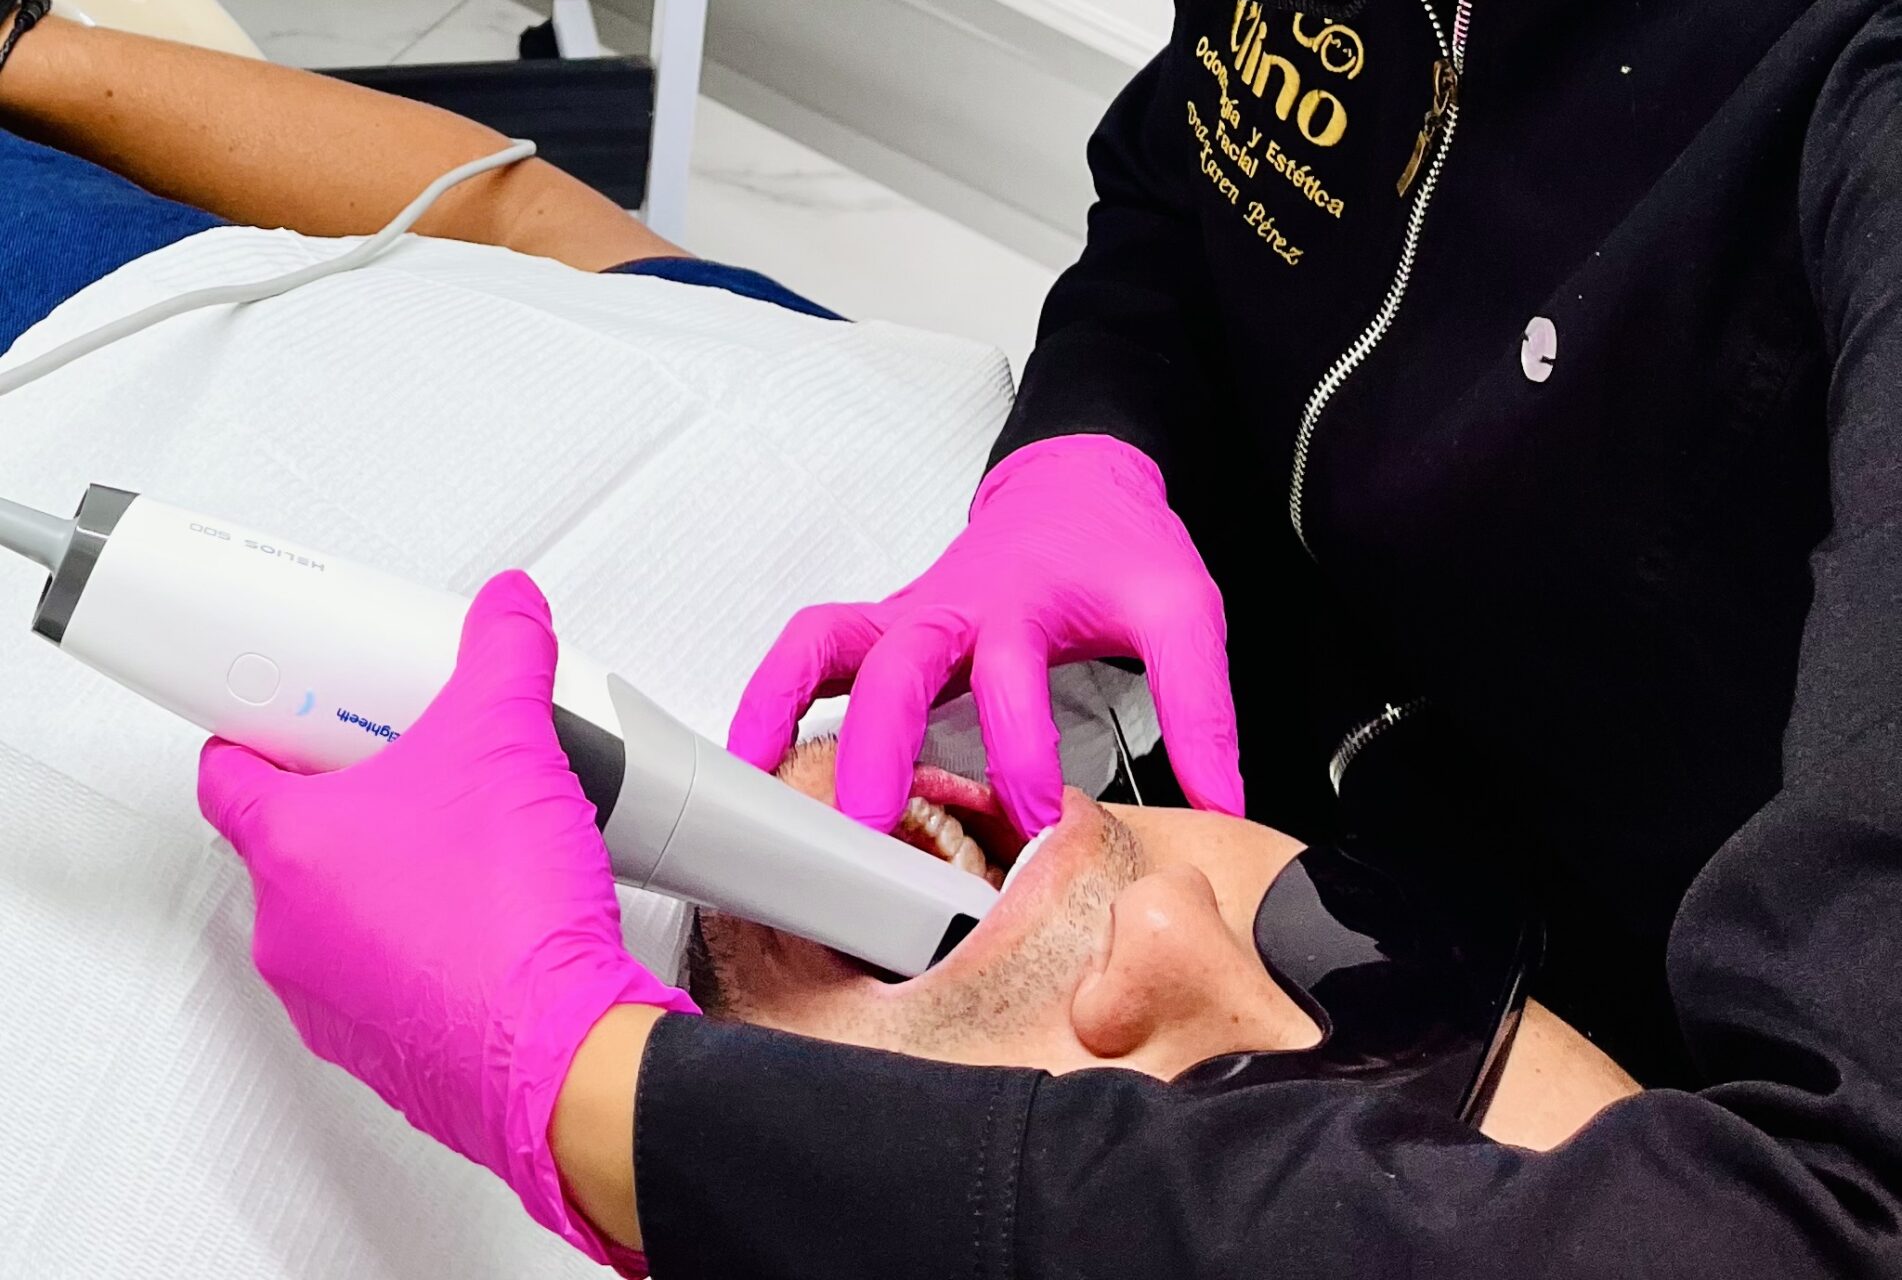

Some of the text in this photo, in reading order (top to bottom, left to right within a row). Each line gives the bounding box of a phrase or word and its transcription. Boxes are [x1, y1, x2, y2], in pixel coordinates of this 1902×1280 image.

[1216, 119, 1259, 178] Facial
[1247, 127, 1263, 148] y
[1266, 141, 1345, 218] Estética
[1243, 202, 1304, 265] Pérez
[189, 522, 325, 572] HELIOS 500
